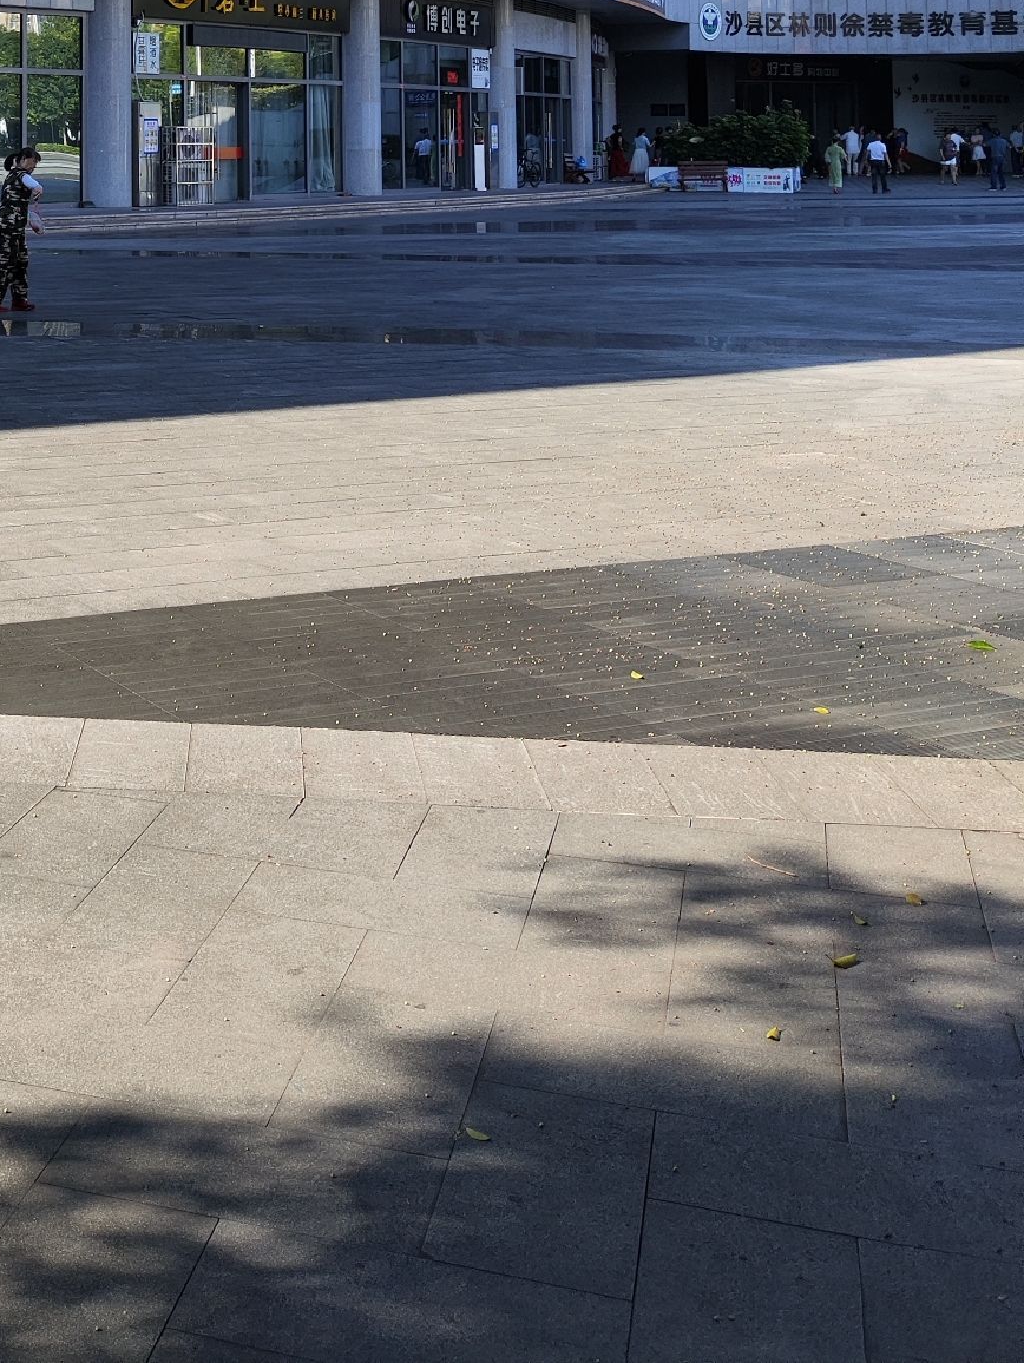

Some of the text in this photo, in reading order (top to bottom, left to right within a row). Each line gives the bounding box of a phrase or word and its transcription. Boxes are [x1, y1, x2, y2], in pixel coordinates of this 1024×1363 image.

[426, 4, 480, 37] 博创电子
[725, 9, 1024, 38] 沙县区林则徐禁毒教育基
